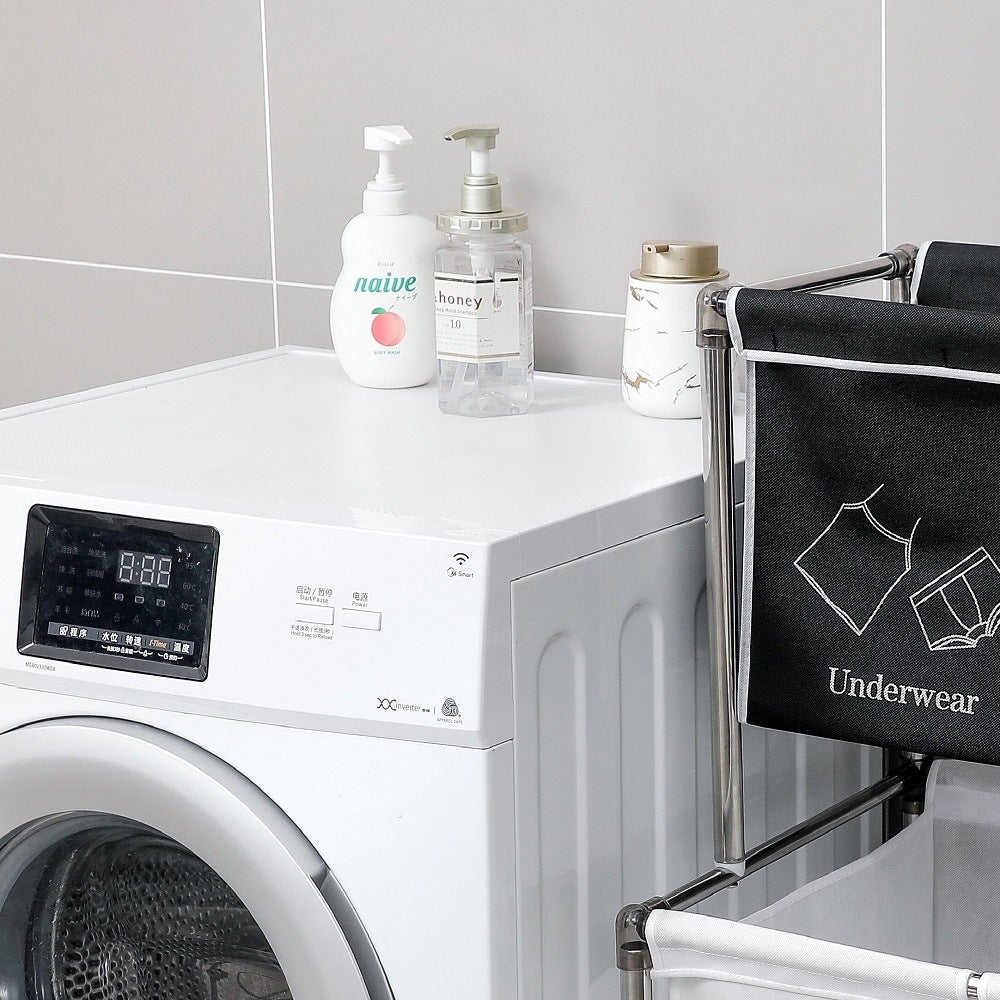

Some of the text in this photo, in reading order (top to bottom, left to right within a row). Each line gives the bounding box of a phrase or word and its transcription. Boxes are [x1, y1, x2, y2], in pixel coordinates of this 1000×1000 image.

[353, 272, 417, 293] naive
[450, 319, 461, 329] 1.0
[352, 592, 369, 602] 电源
[70, 627, 87, 638] 程序
[102, 631, 119, 643] 水位
[173, 641, 190, 653] 温度
[828, 667, 980, 715] Underwear
[395, 703, 421, 712] inverter
